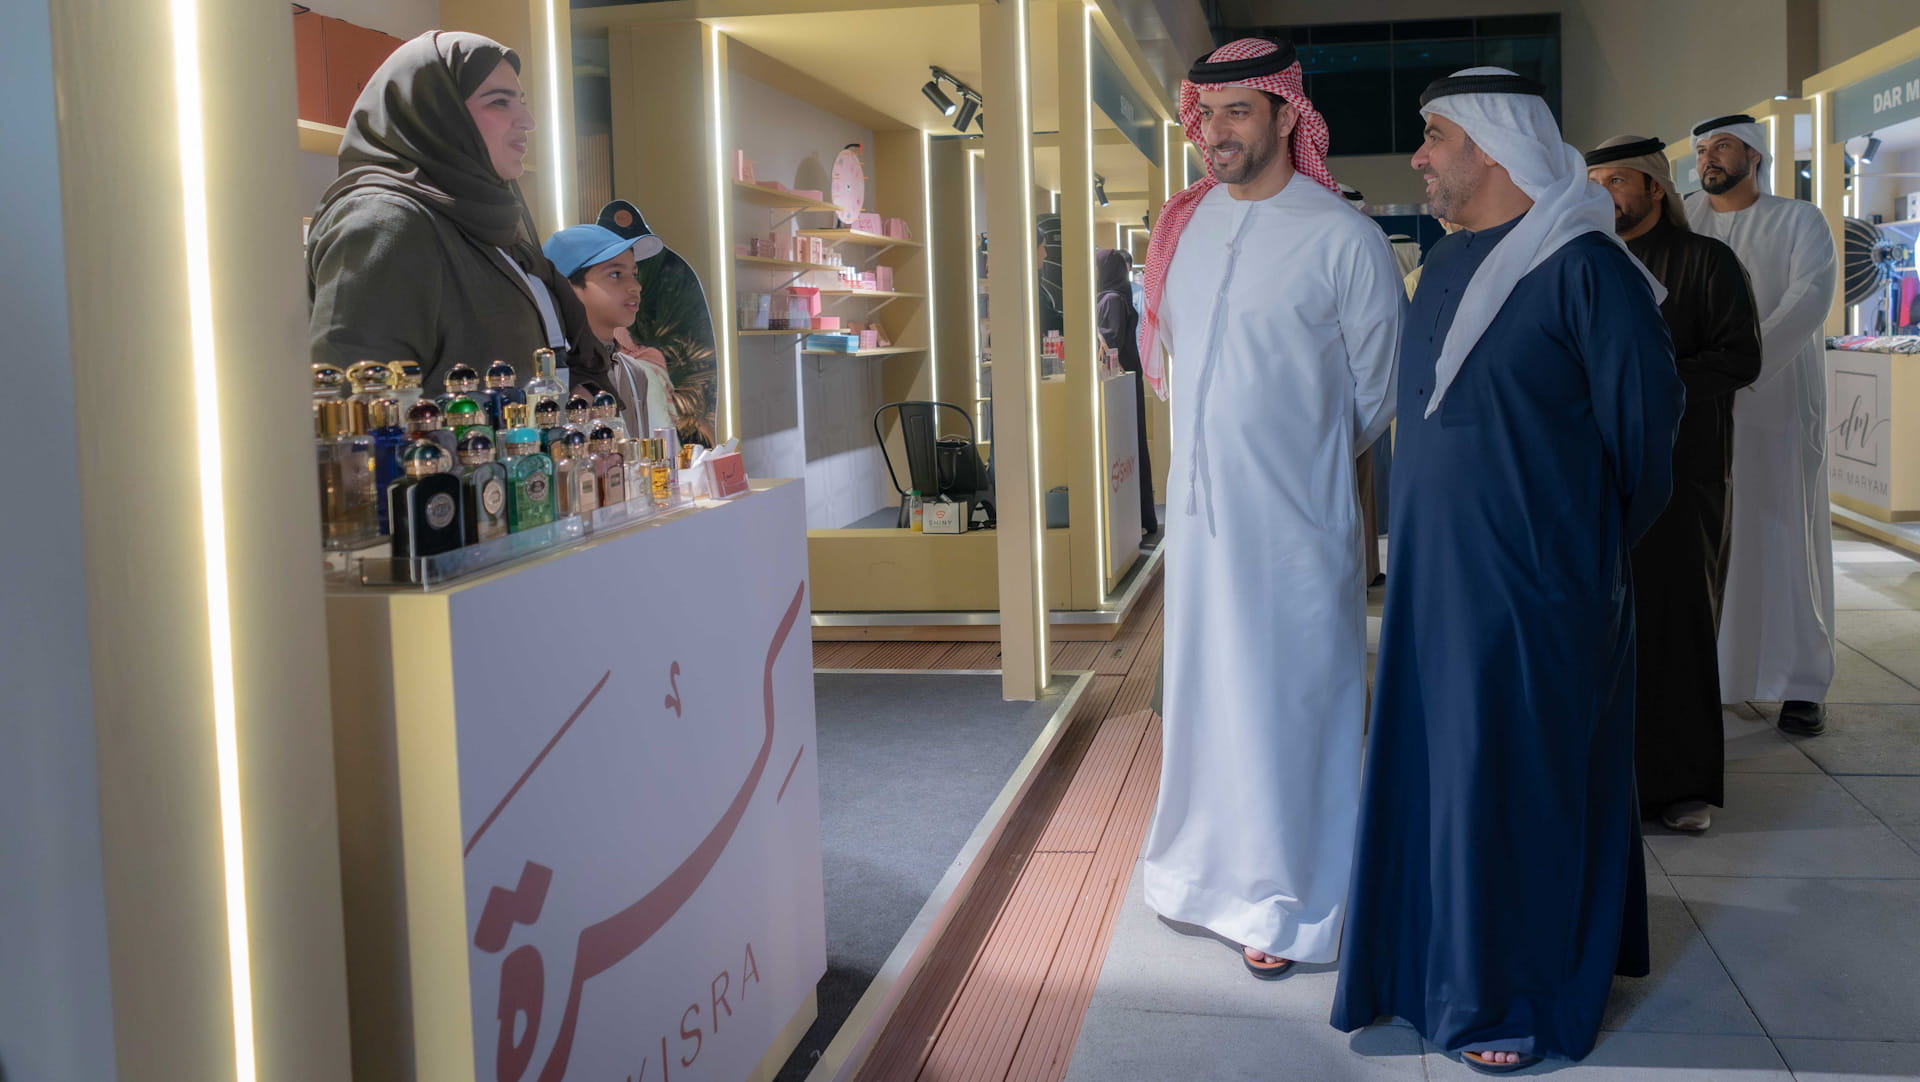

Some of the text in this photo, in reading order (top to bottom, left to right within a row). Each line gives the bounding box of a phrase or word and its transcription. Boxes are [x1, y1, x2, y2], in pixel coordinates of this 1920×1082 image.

[1873, 86, 1903, 114] DAR
[1847, 471, 1888, 497] MARYAM
[928, 519, 953, 527] SHINY
[626, 942, 760, 1082] ISRA
